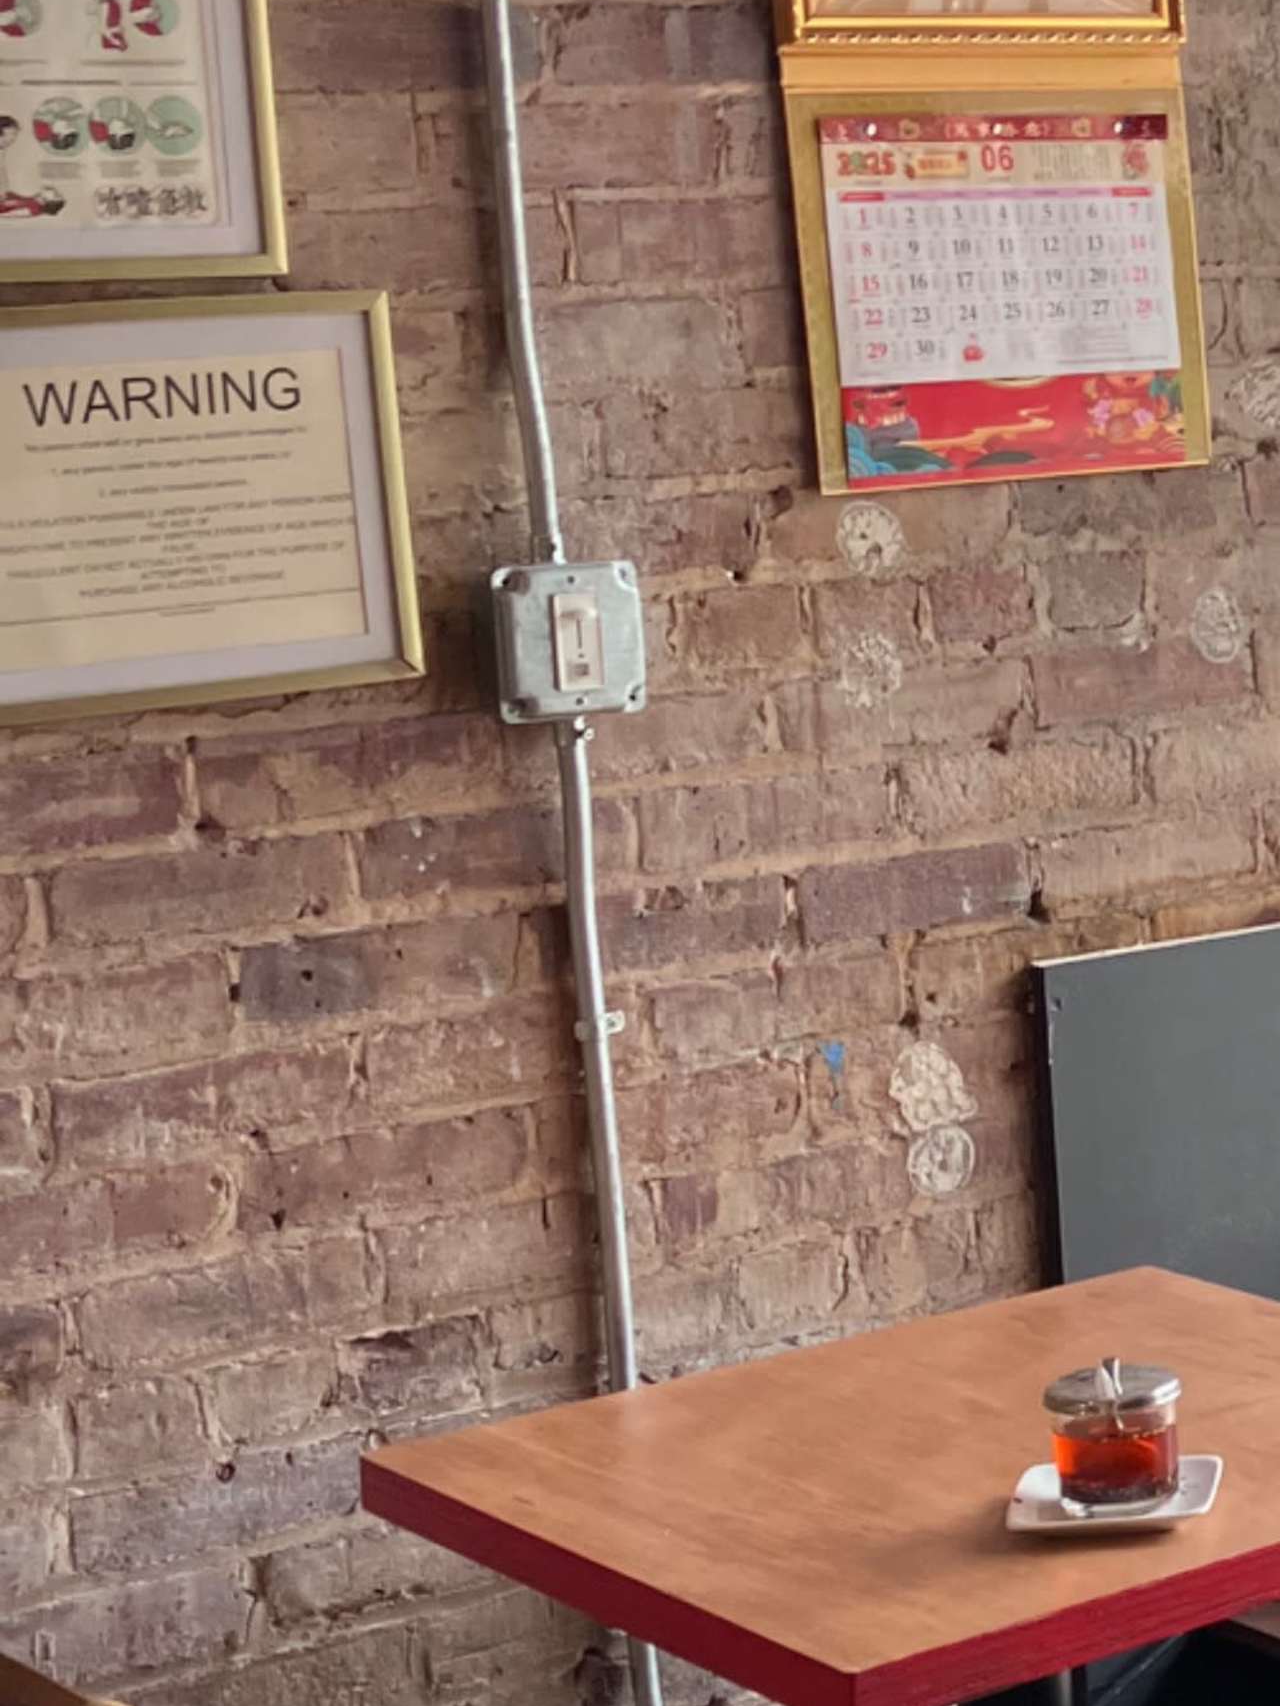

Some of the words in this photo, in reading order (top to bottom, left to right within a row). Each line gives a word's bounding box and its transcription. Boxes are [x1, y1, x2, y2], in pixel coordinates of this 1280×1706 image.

[980, 145, 1015, 173] 06
[905, 206, 916, 224] 2
[953, 205, 963, 221] 3
[999, 204, 1008, 219] 4
[1043, 203, 1052, 219] 5
[1087, 203, 1098, 219] 6
[908, 240, 920, 255] 9
[953, 239, 971, 256] 10
[999, 238, 1014, 254] 11
[1042, 235, 1060, 252] 12
[1088, 234, 1104, 252] 13
[862, 274, 880, 291] 15
[909, 273, 928, 291] 16
[957, 271, 974, 288] 17
[1002, 270, 1019, 287] 18
[1045, 269, 1063, 286] 19
[1088, 267, 1108, 283] 20
[864, 308, 883, 326] 22
[911, 307, 931, 323] 23
[959, 304, 977, 321] 24
[1003, 302, 1022, 320] 25
[1048, 301, 1065, 318] 26
[1092, 299, 1109, 315] 27
[867, 343, 888, 360] 29
[916, 340, 935, 356] 30
[22, 366, 301, 428] WARNING
